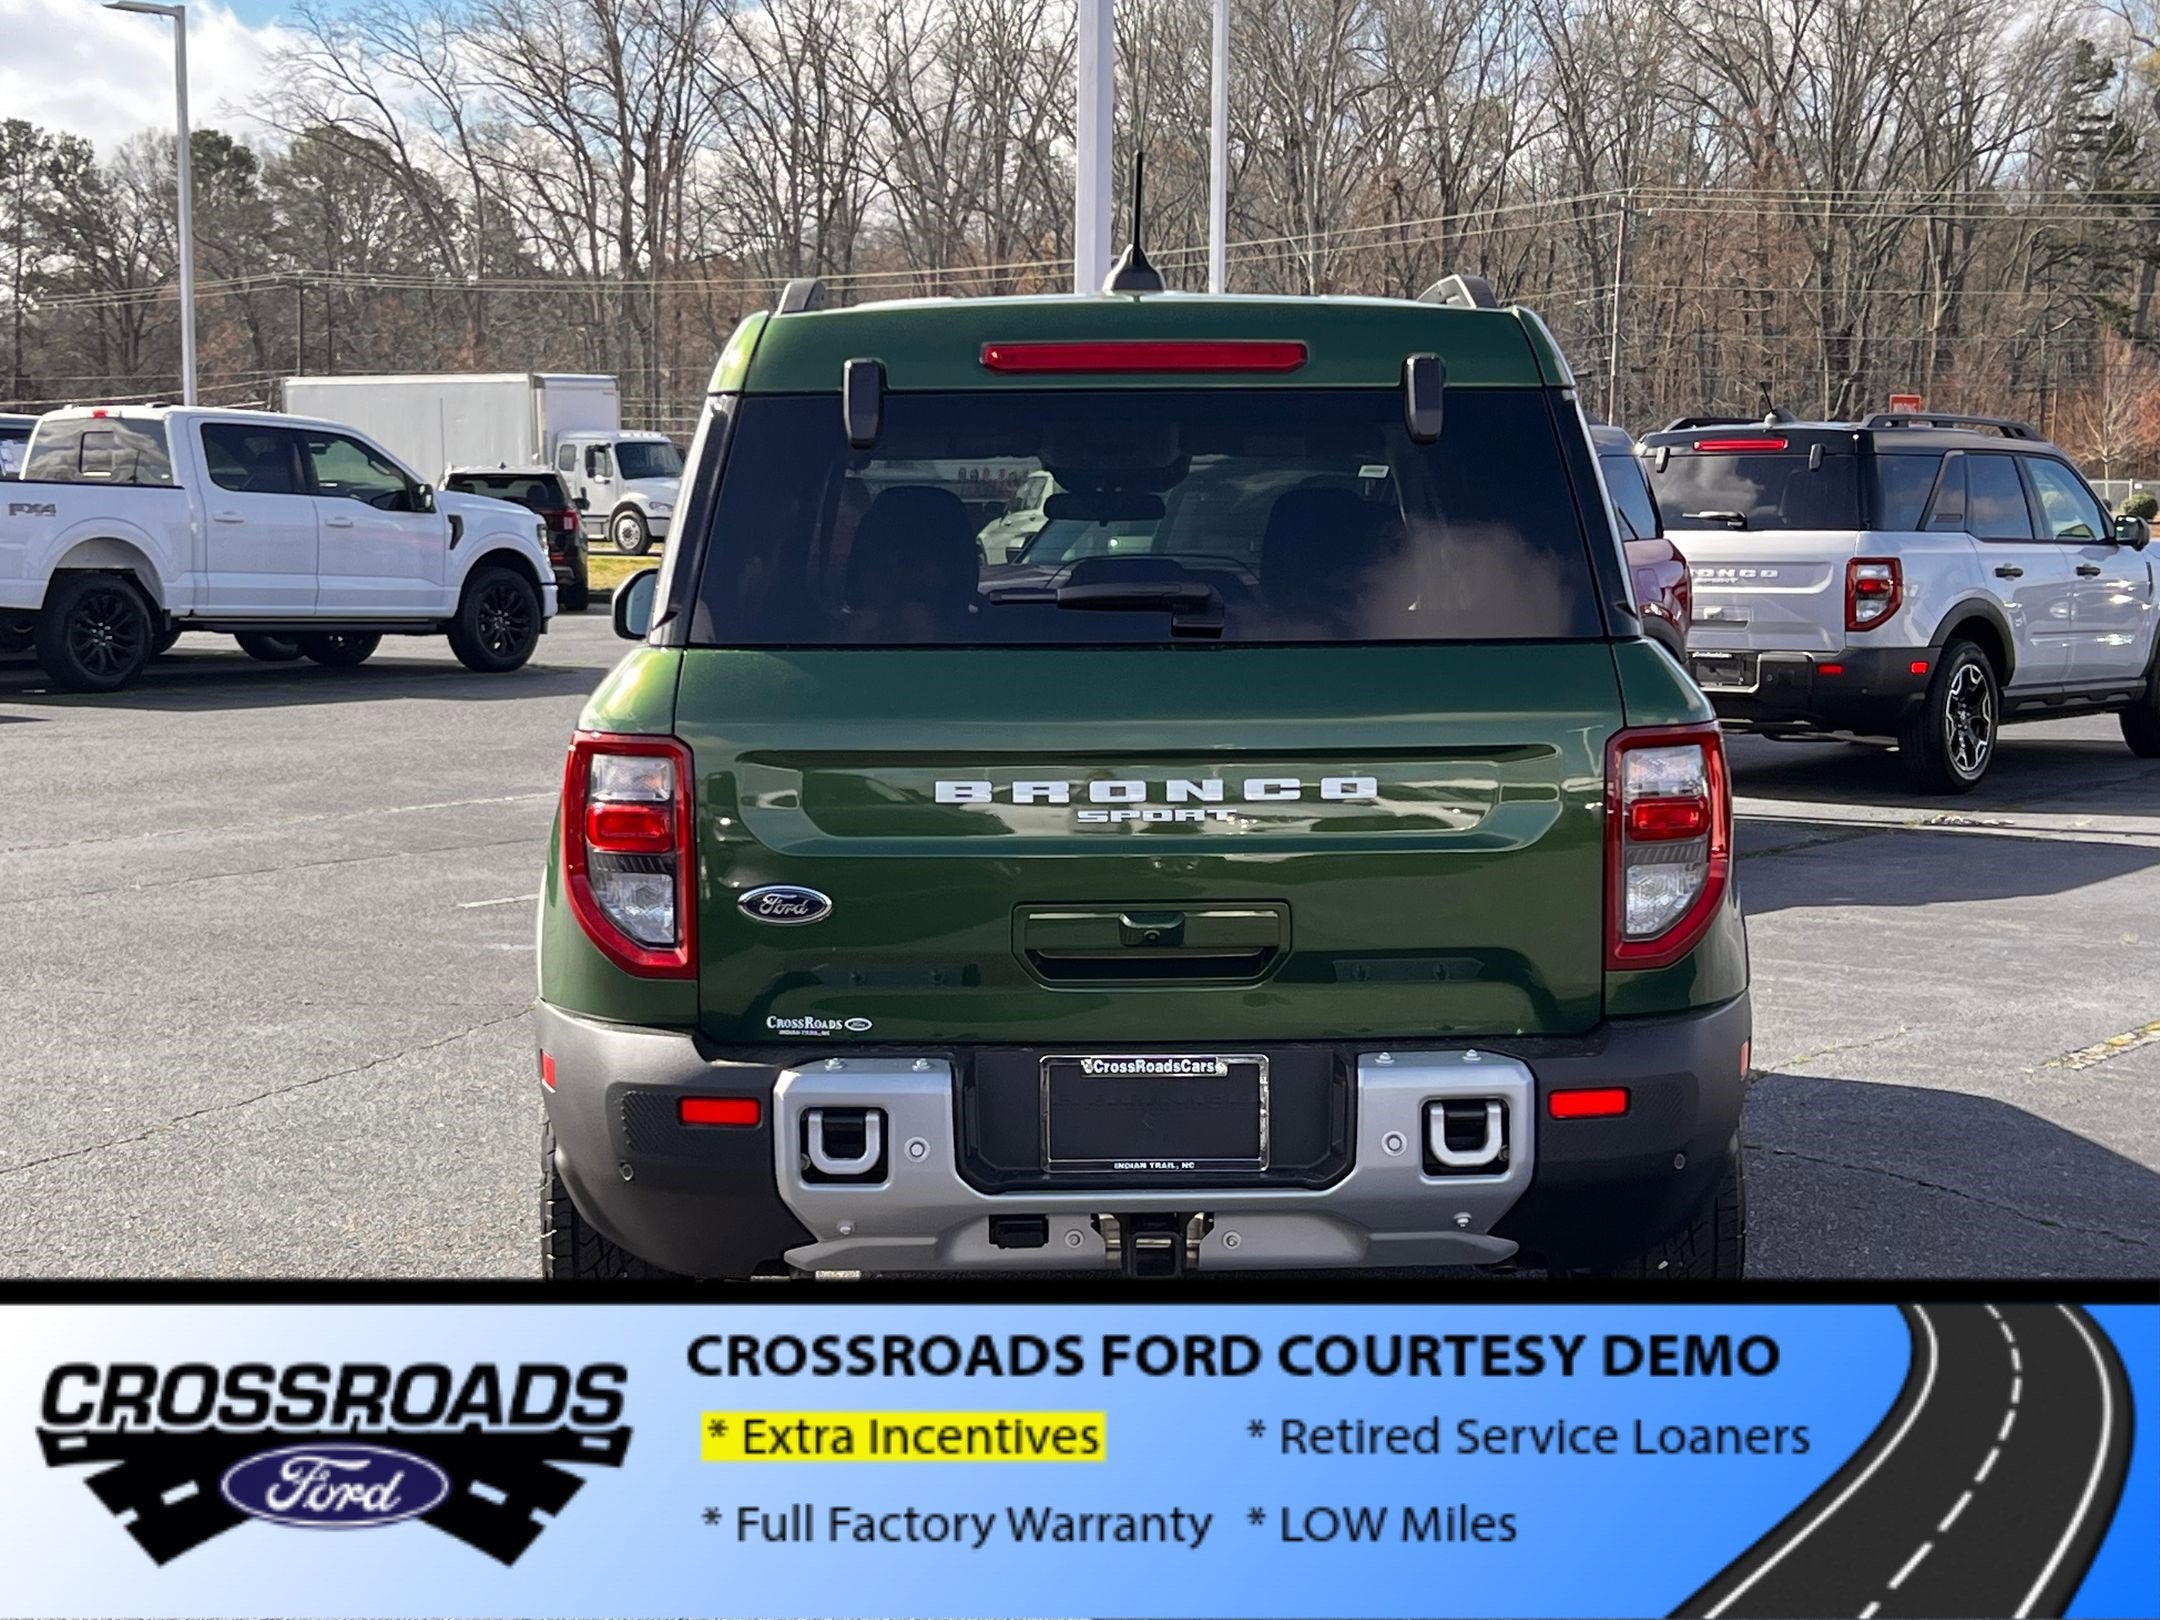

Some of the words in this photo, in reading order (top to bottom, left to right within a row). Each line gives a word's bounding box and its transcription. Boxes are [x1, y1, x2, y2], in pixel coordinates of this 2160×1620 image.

[934, 777, 1378, 803] BRONCO
[1078, 809, 1237, 823] SPORT
[759, 893, 808, 915] Ford
[1093, 1059, 1215, 1073] CrossRoadsCars
